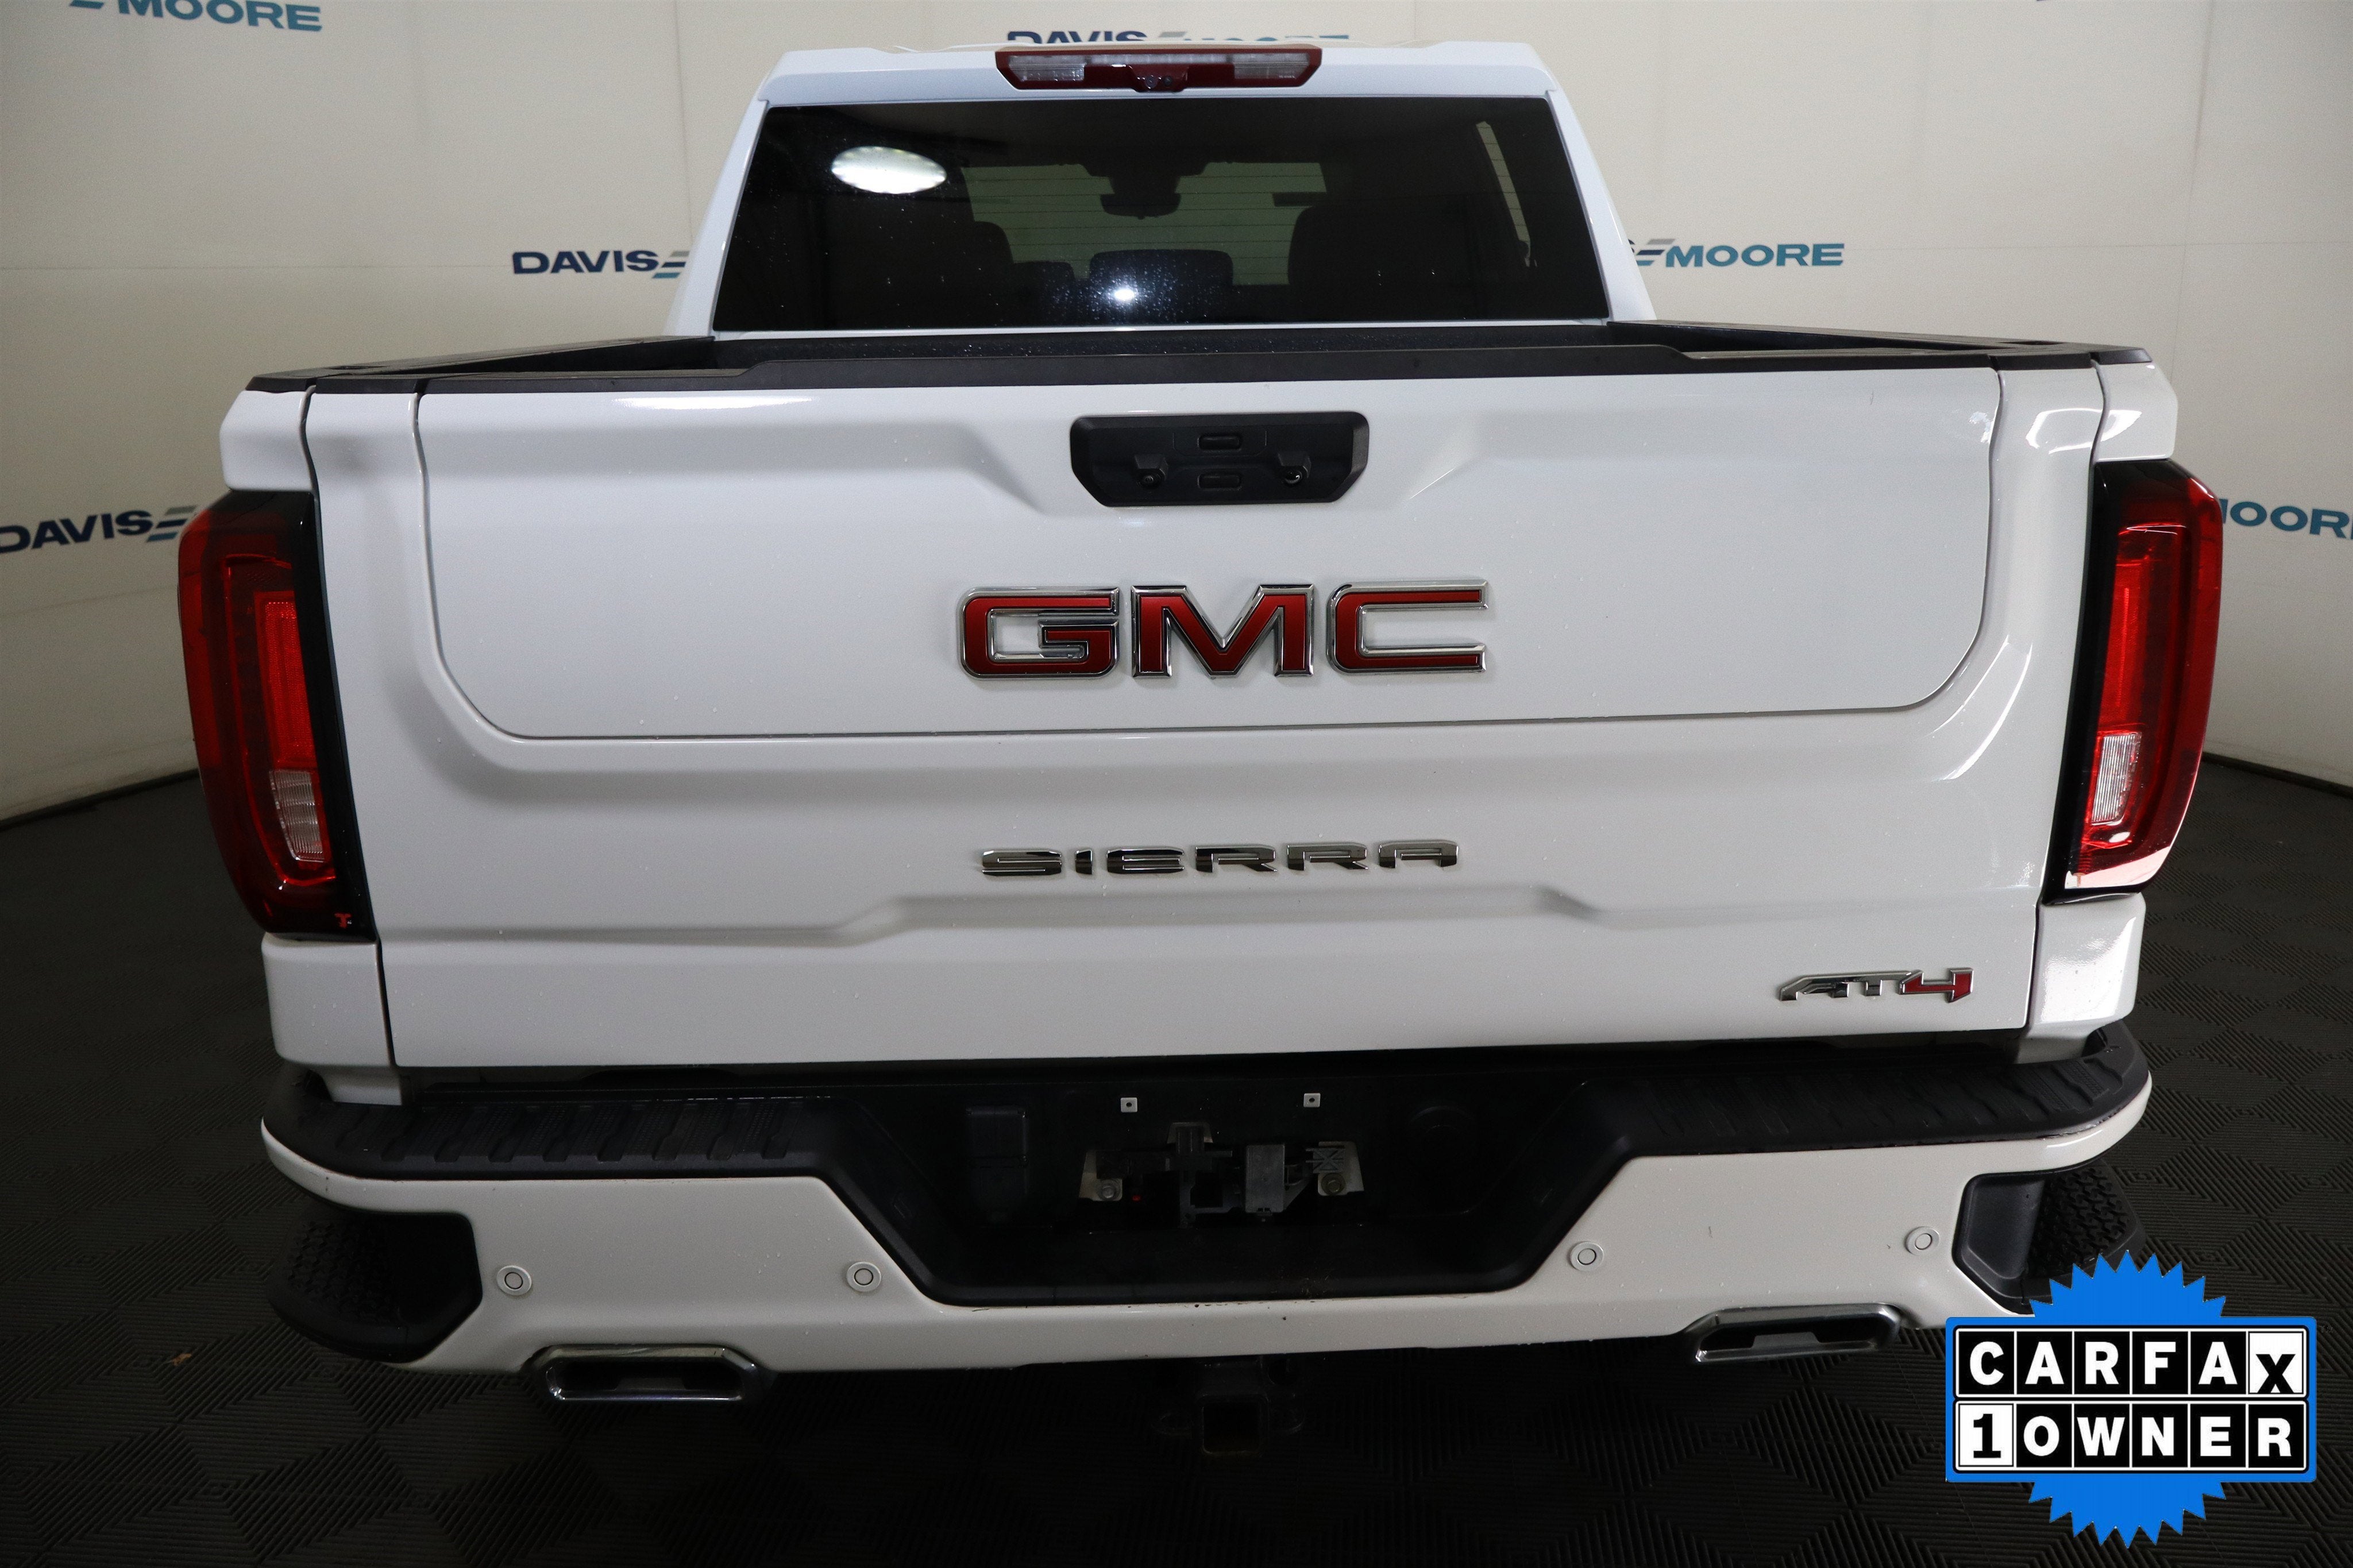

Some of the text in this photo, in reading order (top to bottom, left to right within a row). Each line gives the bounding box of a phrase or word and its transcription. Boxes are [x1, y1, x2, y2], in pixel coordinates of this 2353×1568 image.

[118, 0, 322, 32] MOORE
[512, 250, 659, 275] DAVIS
[1666, 243, 1845, 268] MOORE
[0, 510, 153, 554] DAVIS
[2219, 498, 2353, 540] OOR
[959, 580, 1489, 679] GMC
[981, 840, 1460, 876] SIERRA
[1780, 967, 1973, 1003] AT4
